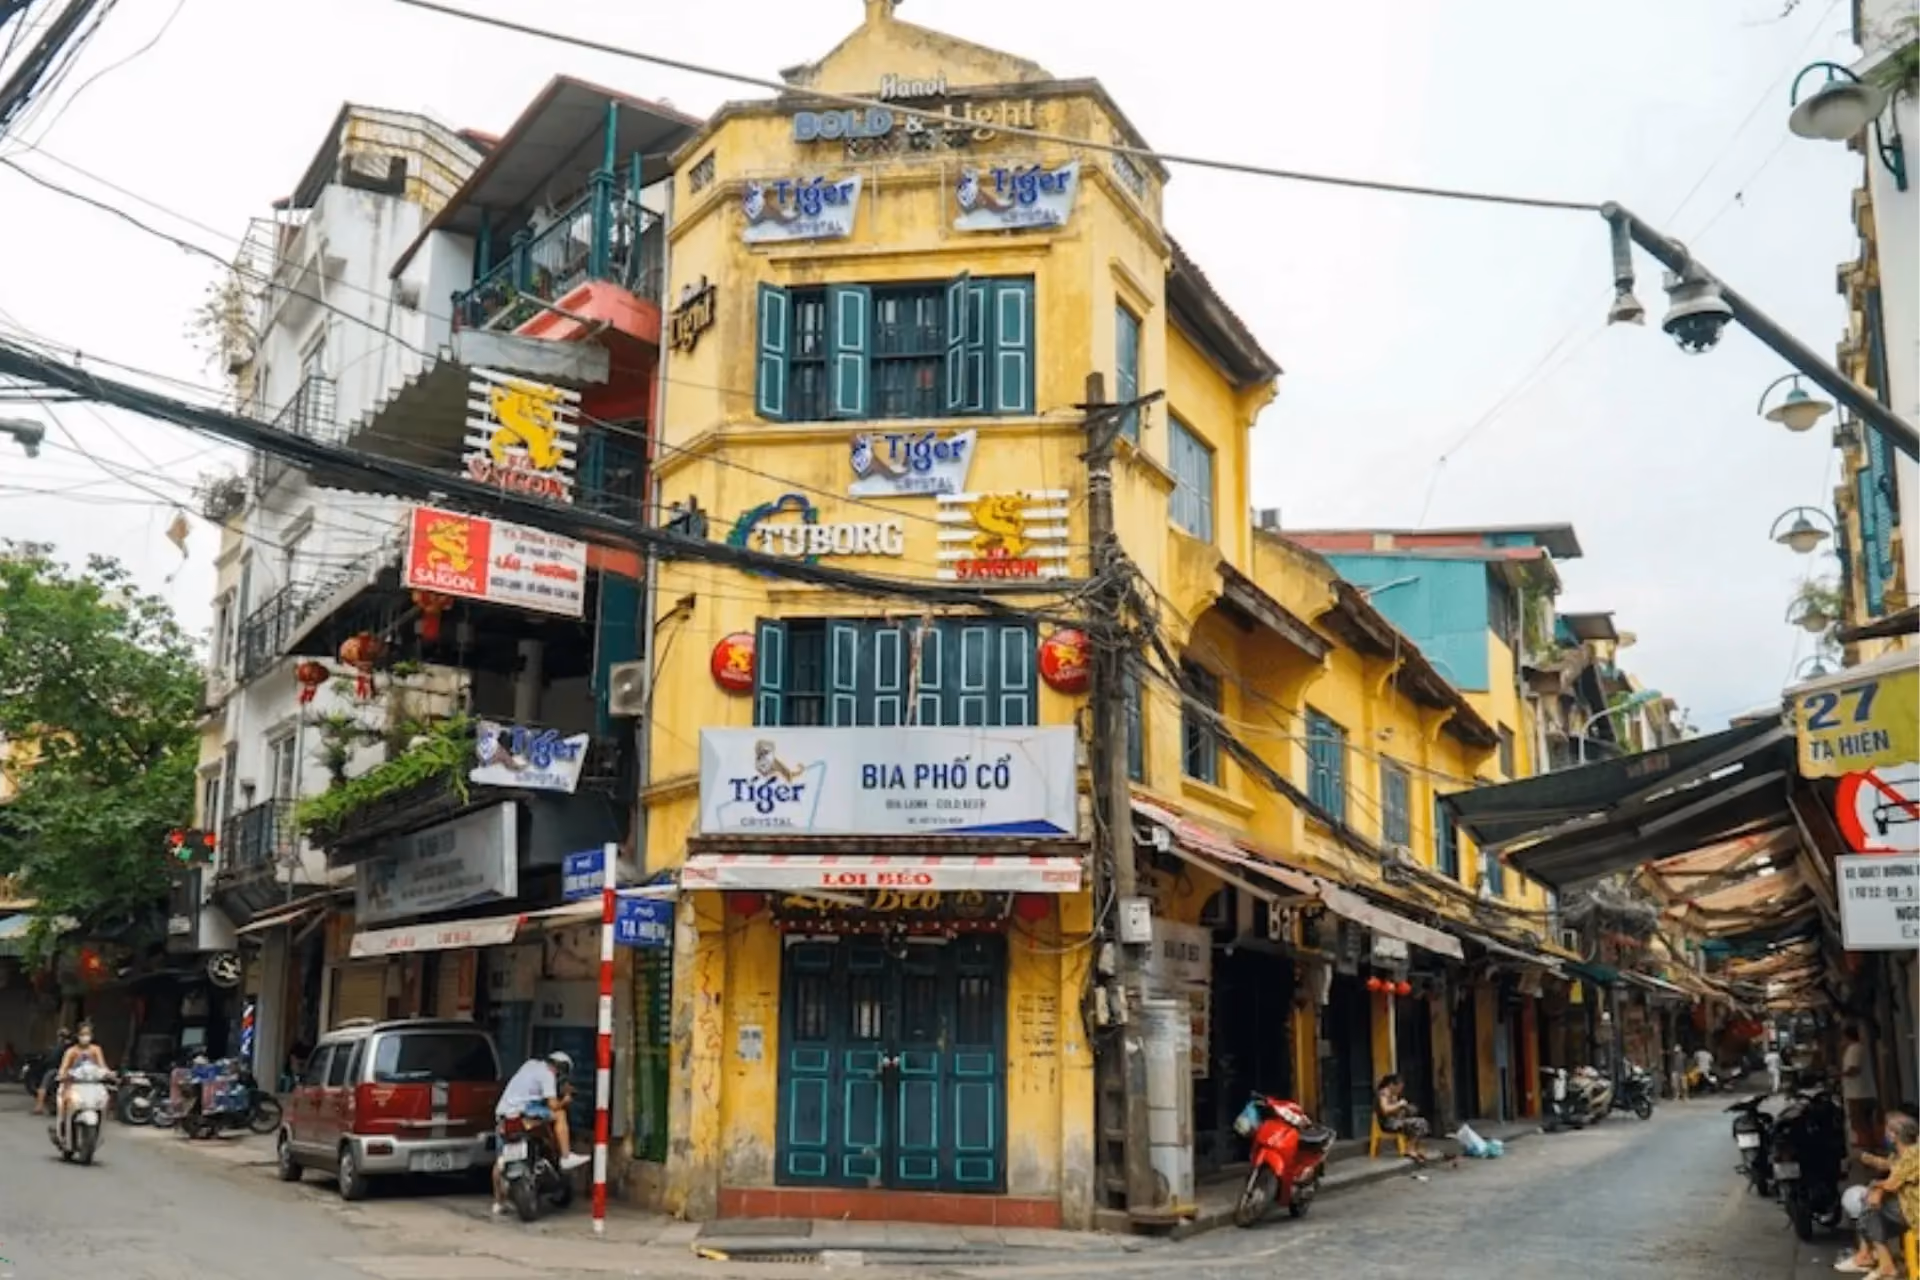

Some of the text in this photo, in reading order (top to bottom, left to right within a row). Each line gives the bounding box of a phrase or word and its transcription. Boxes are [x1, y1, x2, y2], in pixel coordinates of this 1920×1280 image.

[880, 75, 946, 98] Hanoi
[794, 99, 1033, 142] BOLD & Light
[773, 176, 854, 216] Tiger
[989, 166, 1071, 204] Tiger
[884, 431, 966, 472] Tiger
[752, 522, 903, 556] TUBORG
[413, 566, 477, 590] SAIGON
[1804, 682, 1878, 731] 27
[511, 724, 581, 770] Tiger
[862, 753, 1012, 790] BIA PHỐ CỔ
[729, 775, 805, 814] Tiger
